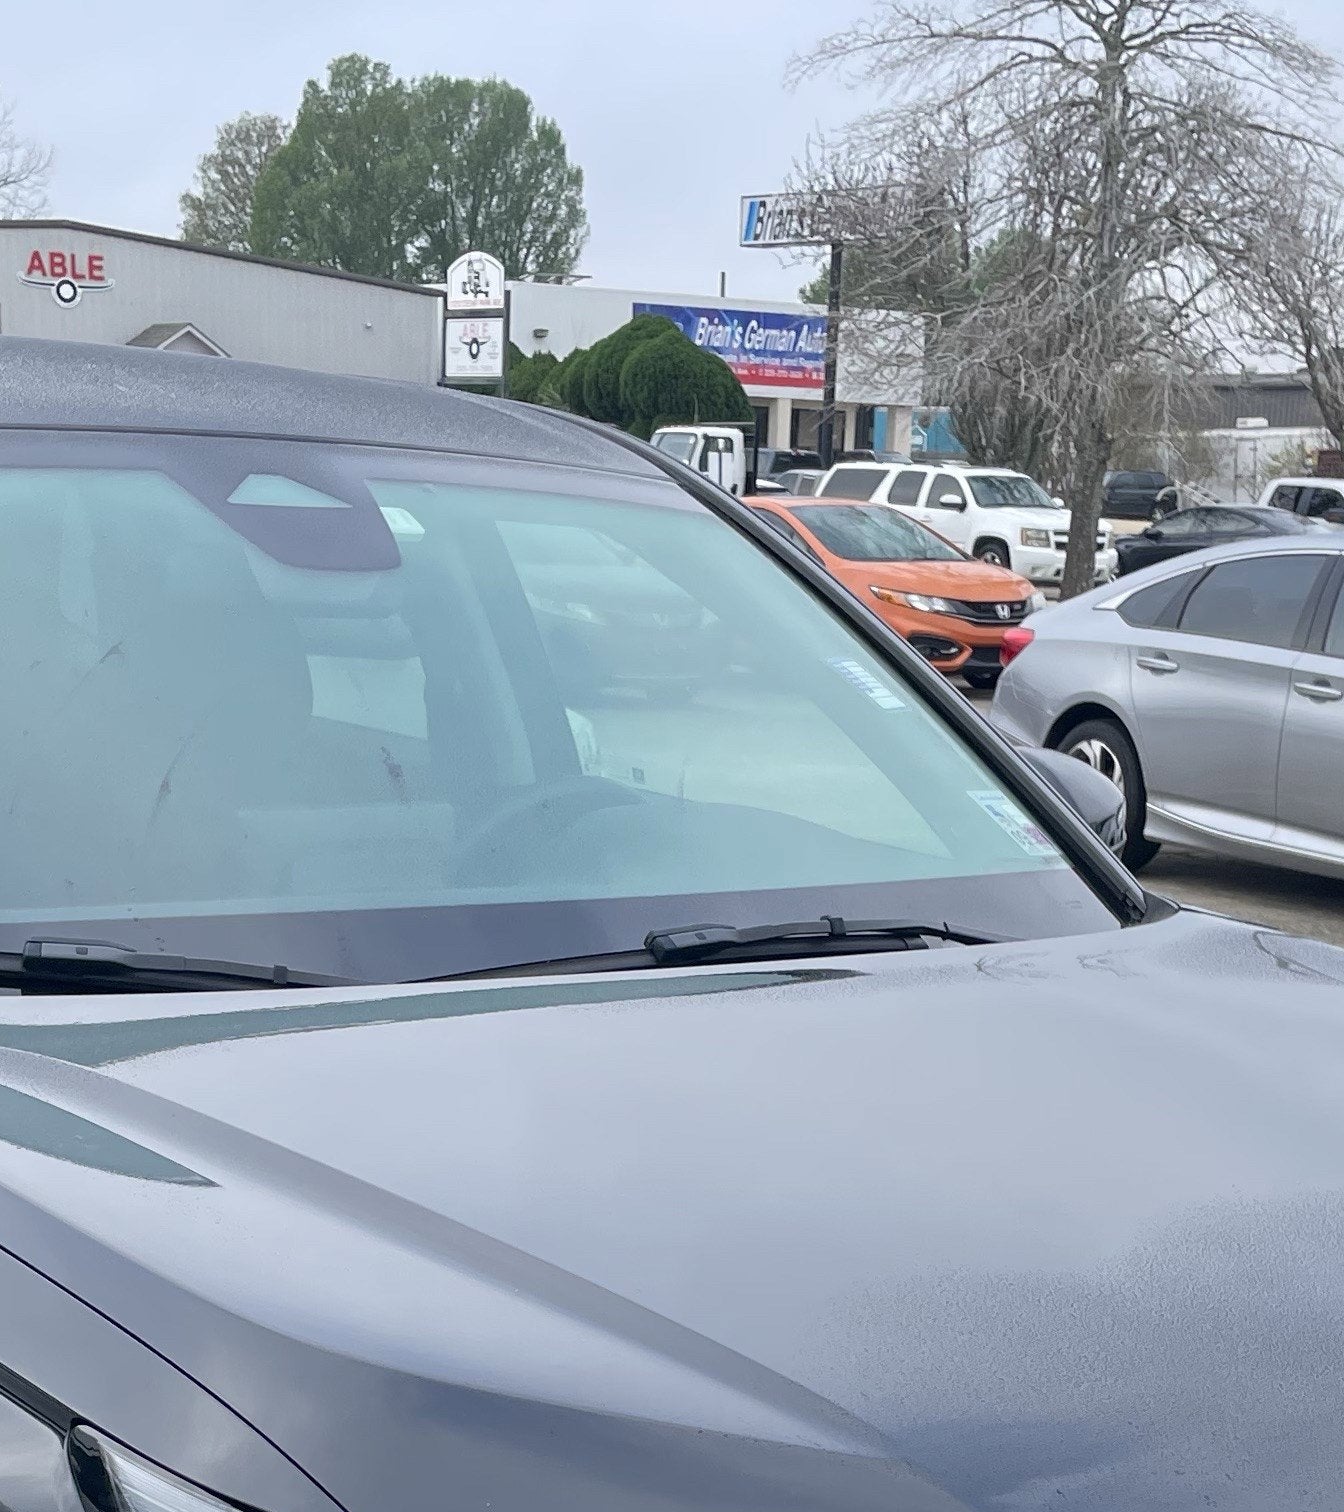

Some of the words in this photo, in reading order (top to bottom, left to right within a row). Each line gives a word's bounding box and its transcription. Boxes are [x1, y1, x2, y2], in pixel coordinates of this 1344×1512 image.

[26, 250, 105, 281] ABLE
[694, 316, 743, 349] Brian's
[744, 319, 797, 352] German
